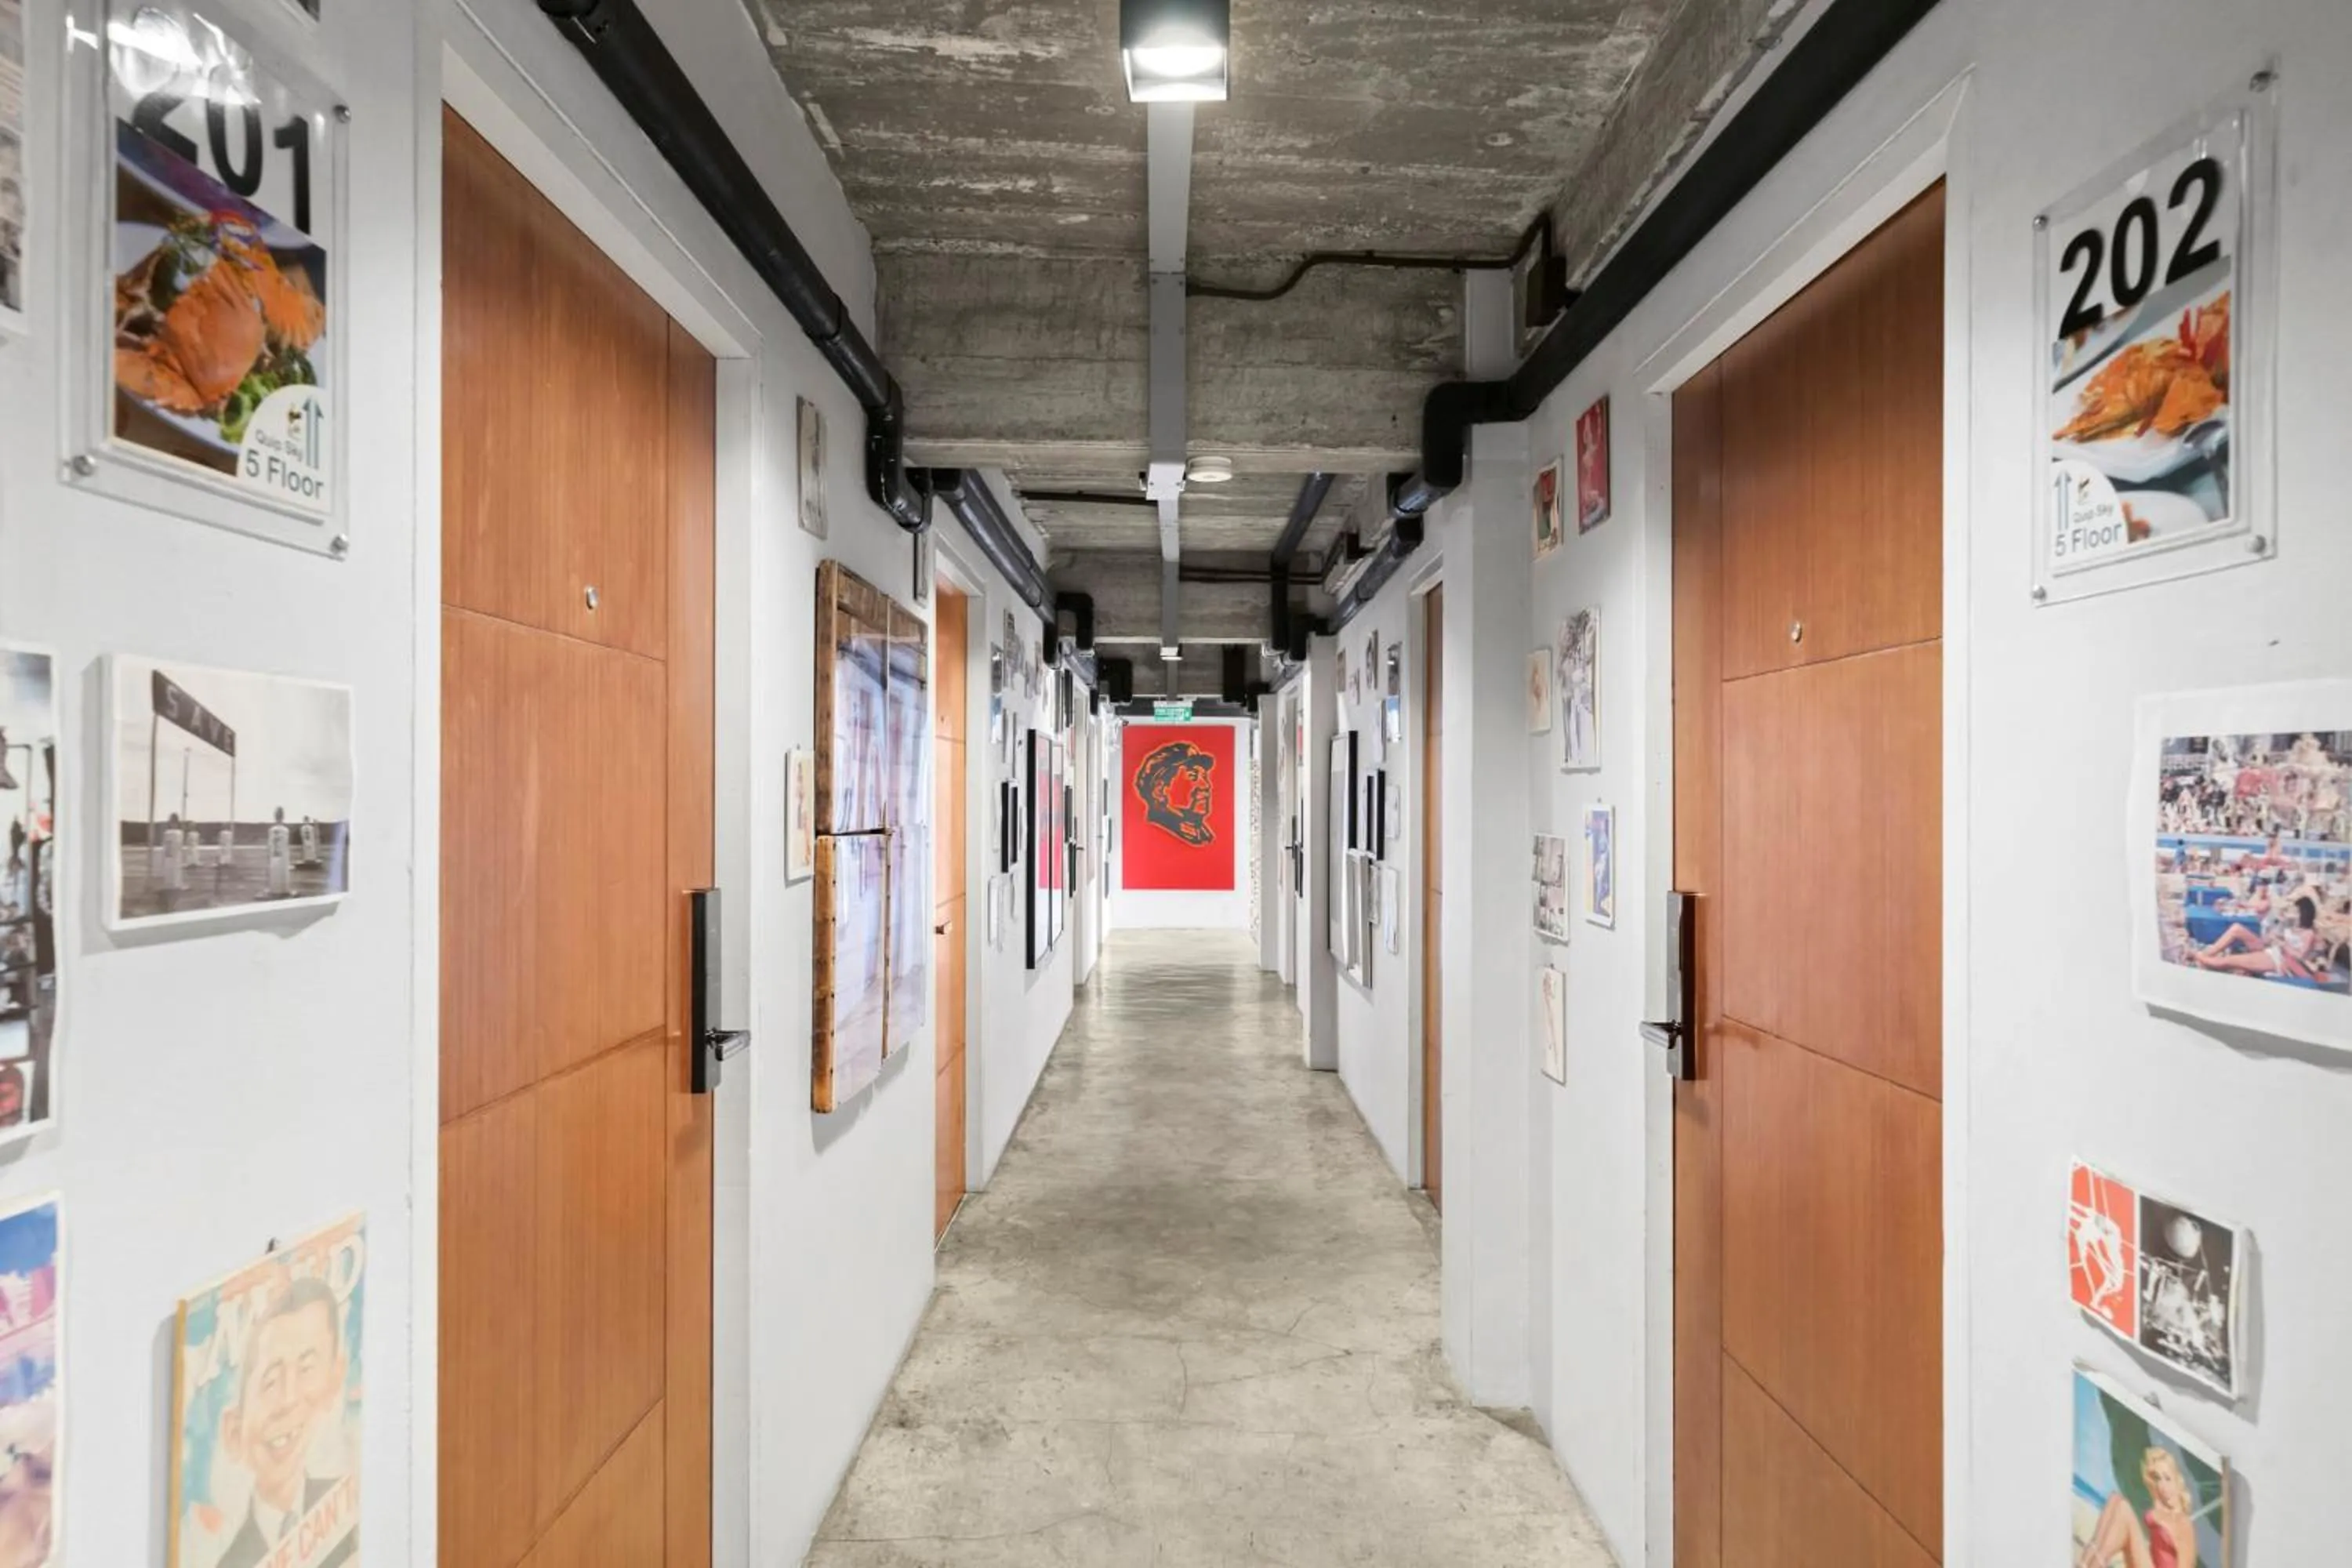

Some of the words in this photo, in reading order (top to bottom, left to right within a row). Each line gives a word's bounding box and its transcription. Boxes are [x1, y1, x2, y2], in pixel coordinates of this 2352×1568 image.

[132, 24, 311, 235] 201
[2059, 158, 2223, 339] 202
[245, 448, 260, 477] 5
[267, 456, 324, 500] Floor
[2054, 534, 2066, 557] 5
[2071, 524, 2122, 553] Floor
